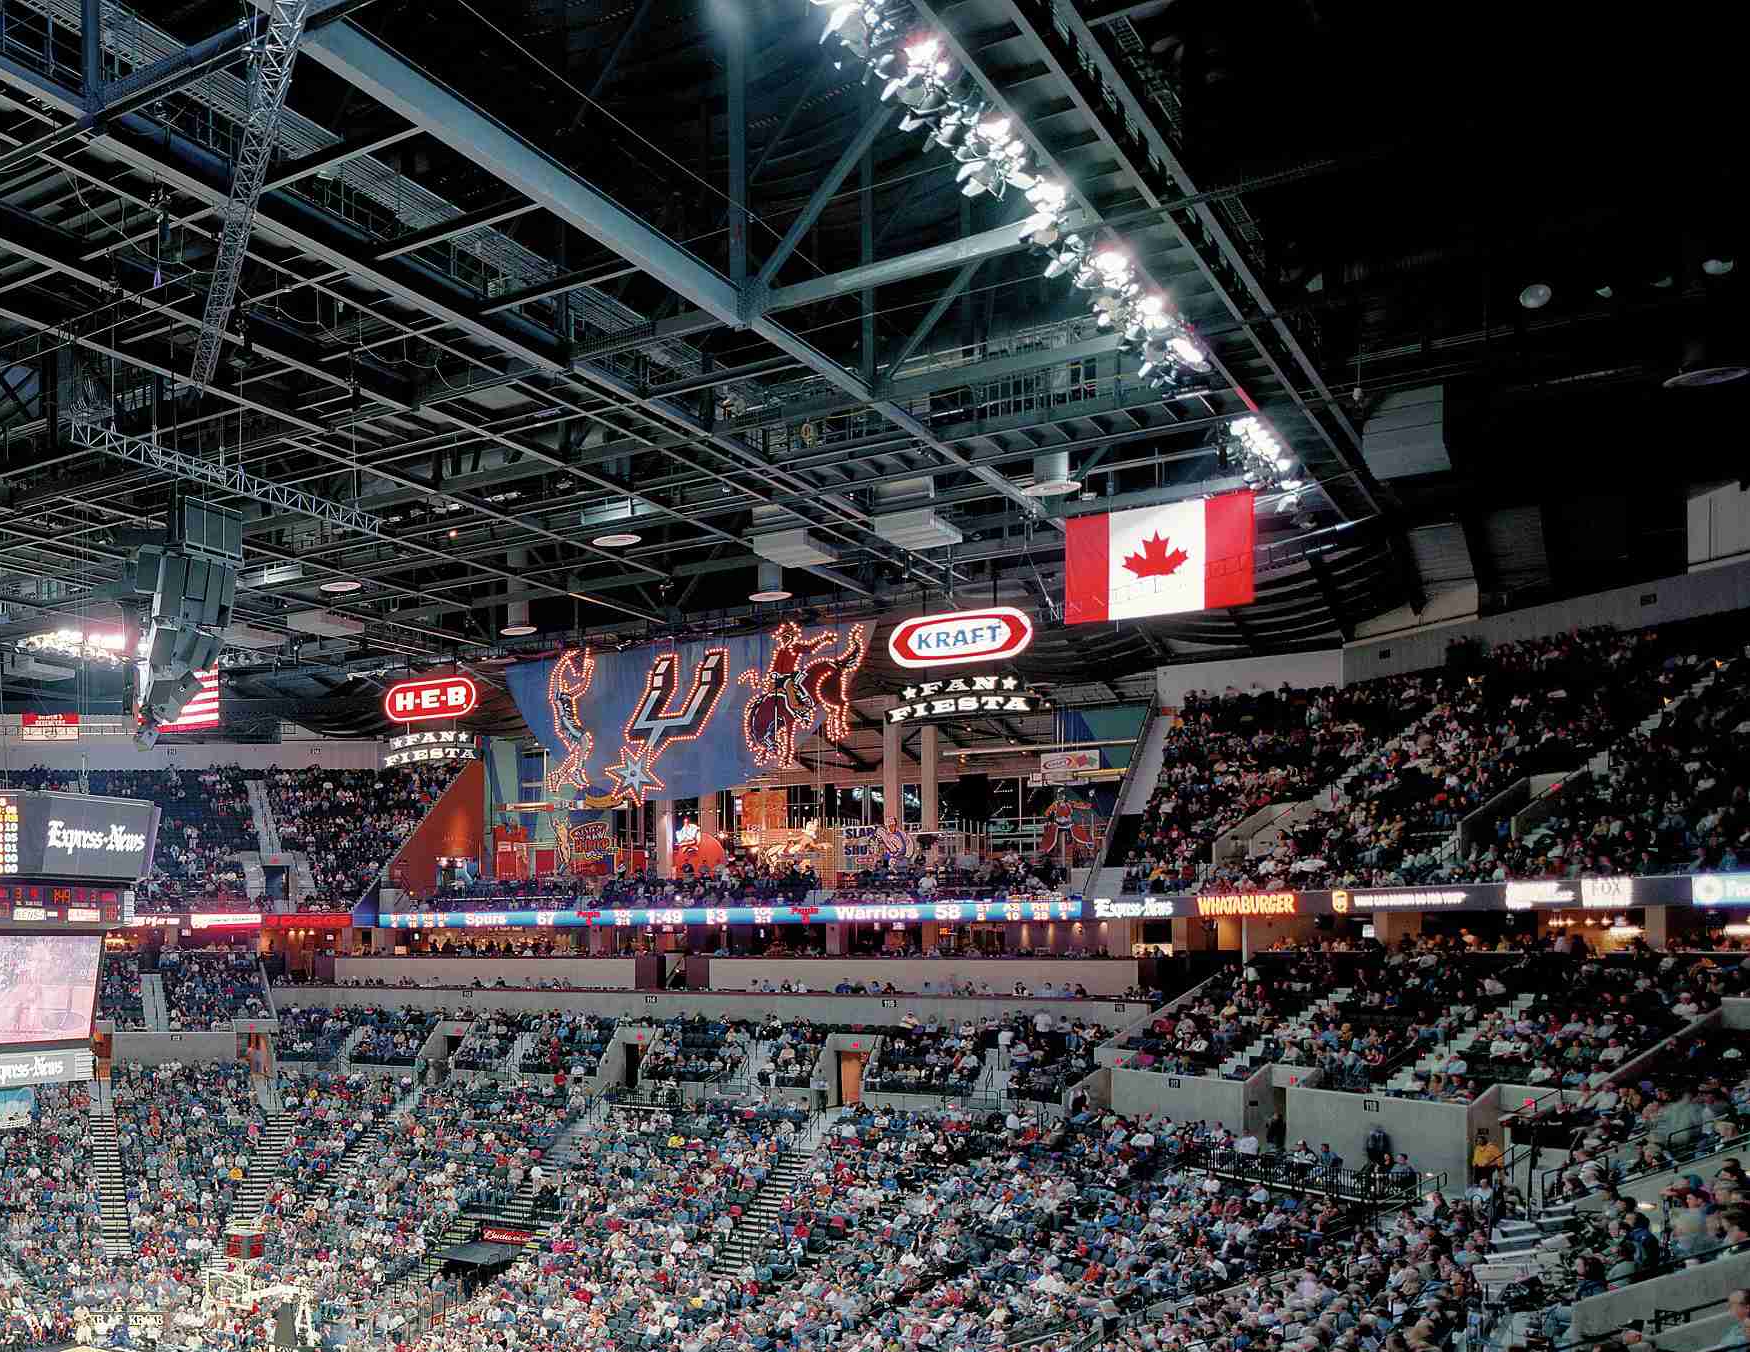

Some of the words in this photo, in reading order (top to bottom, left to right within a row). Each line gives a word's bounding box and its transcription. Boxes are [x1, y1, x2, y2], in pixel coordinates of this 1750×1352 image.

[916, 624, 1001, 651] KRAFT
[919, 676, 999, 697] FAN
[395, 686, 467, 711] H-E-B
[888, 696, 1031, 723] FIESTA
[406, 731, 456, 744] FAN
[384, 748, 477, 767] FIESTA
[4, 823, 18, 832] 10
[4, 833, 18, 843] 05
[47, 821, 146, 857] Express-News
[4, 844, 18, 853] 01
[4, 854, 18, 863] 00
[4, 864, 18, 873] 00
[1593, 880, 1622, 896] FOX
[836, 904, 919, 921] Warriors
[935, 903, 961, 921] 58
[1197, 894, 1295, 916] WHATABURGER
[465, 911, 507, 926] Spurs
[537, 911, 555, 925] 67
[646, 910, 682, 924] 1:49
[717, 908, 728, 923] 3
